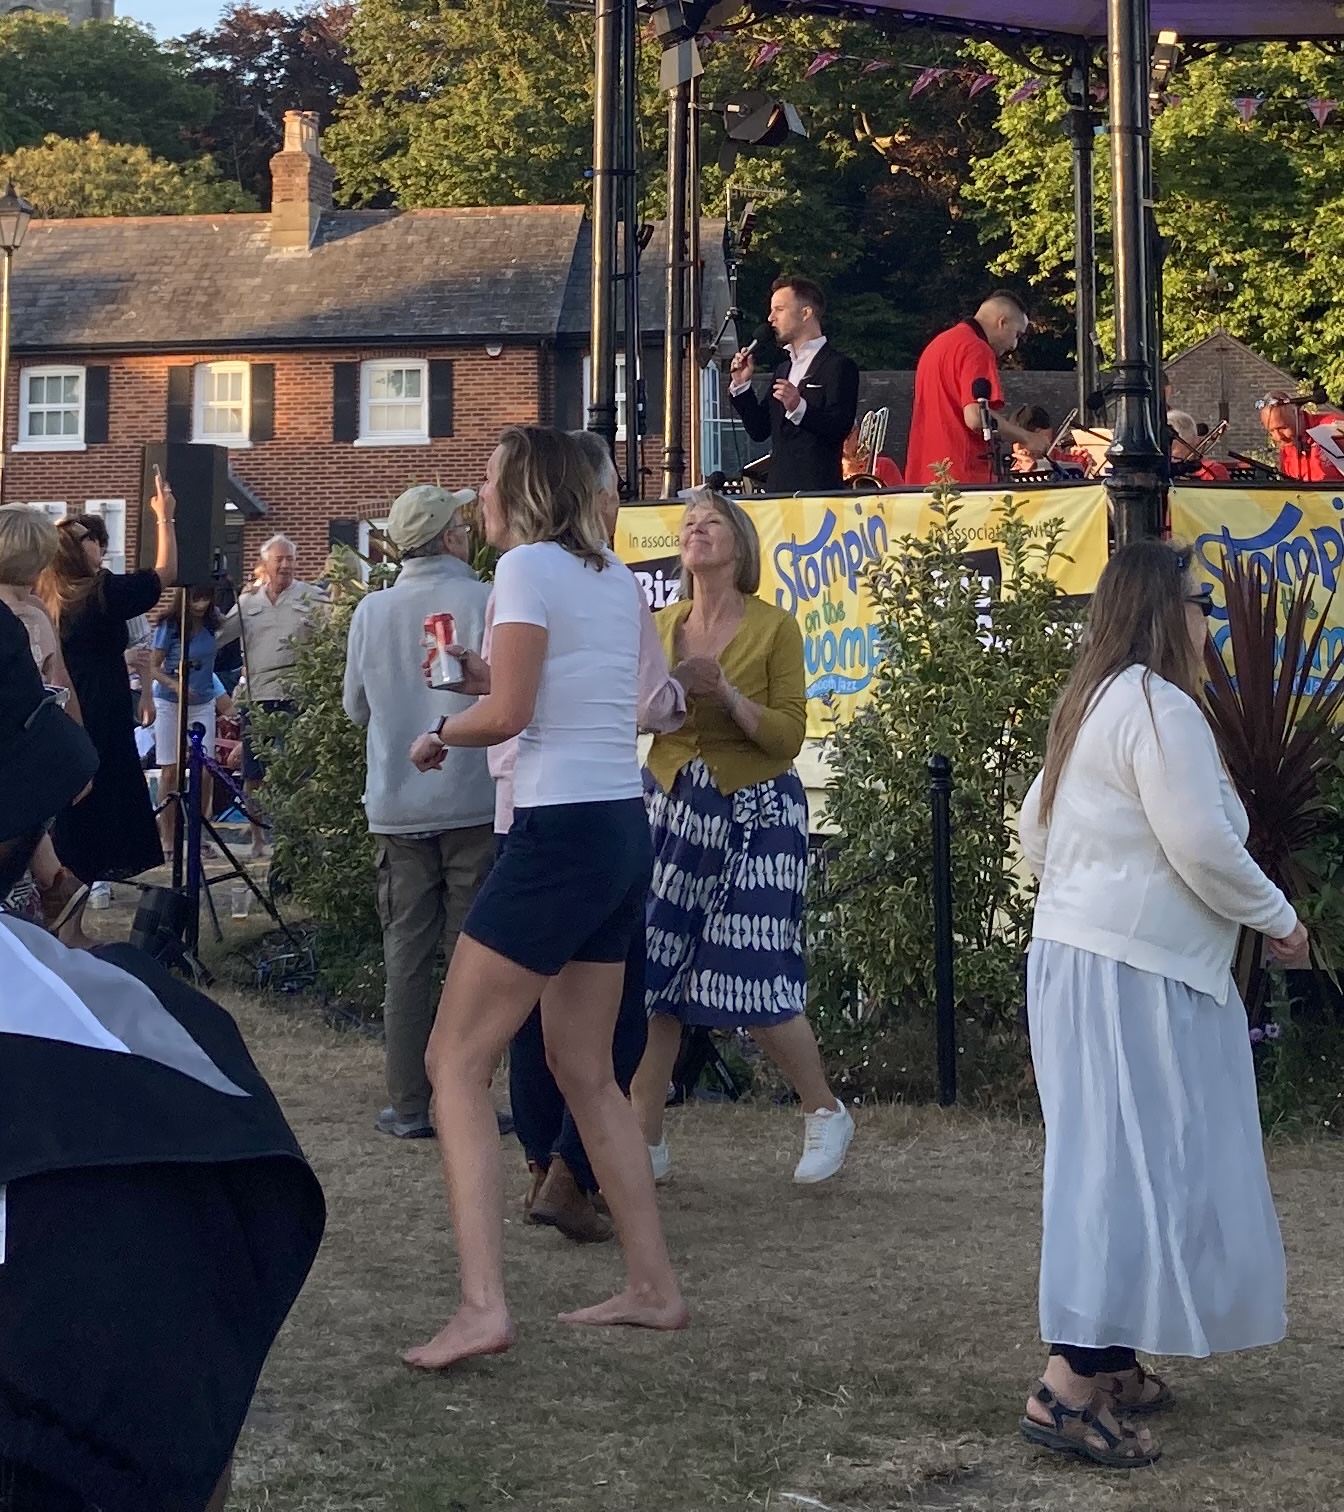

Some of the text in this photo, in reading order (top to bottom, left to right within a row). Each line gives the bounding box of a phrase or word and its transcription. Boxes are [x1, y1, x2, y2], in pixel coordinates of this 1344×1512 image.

[628, 532, 681, 549] In associa
[948, 522, 1000, 541] associat
[805, 590, 846, 633] on the
[805, 623, 886, 678] uomp
